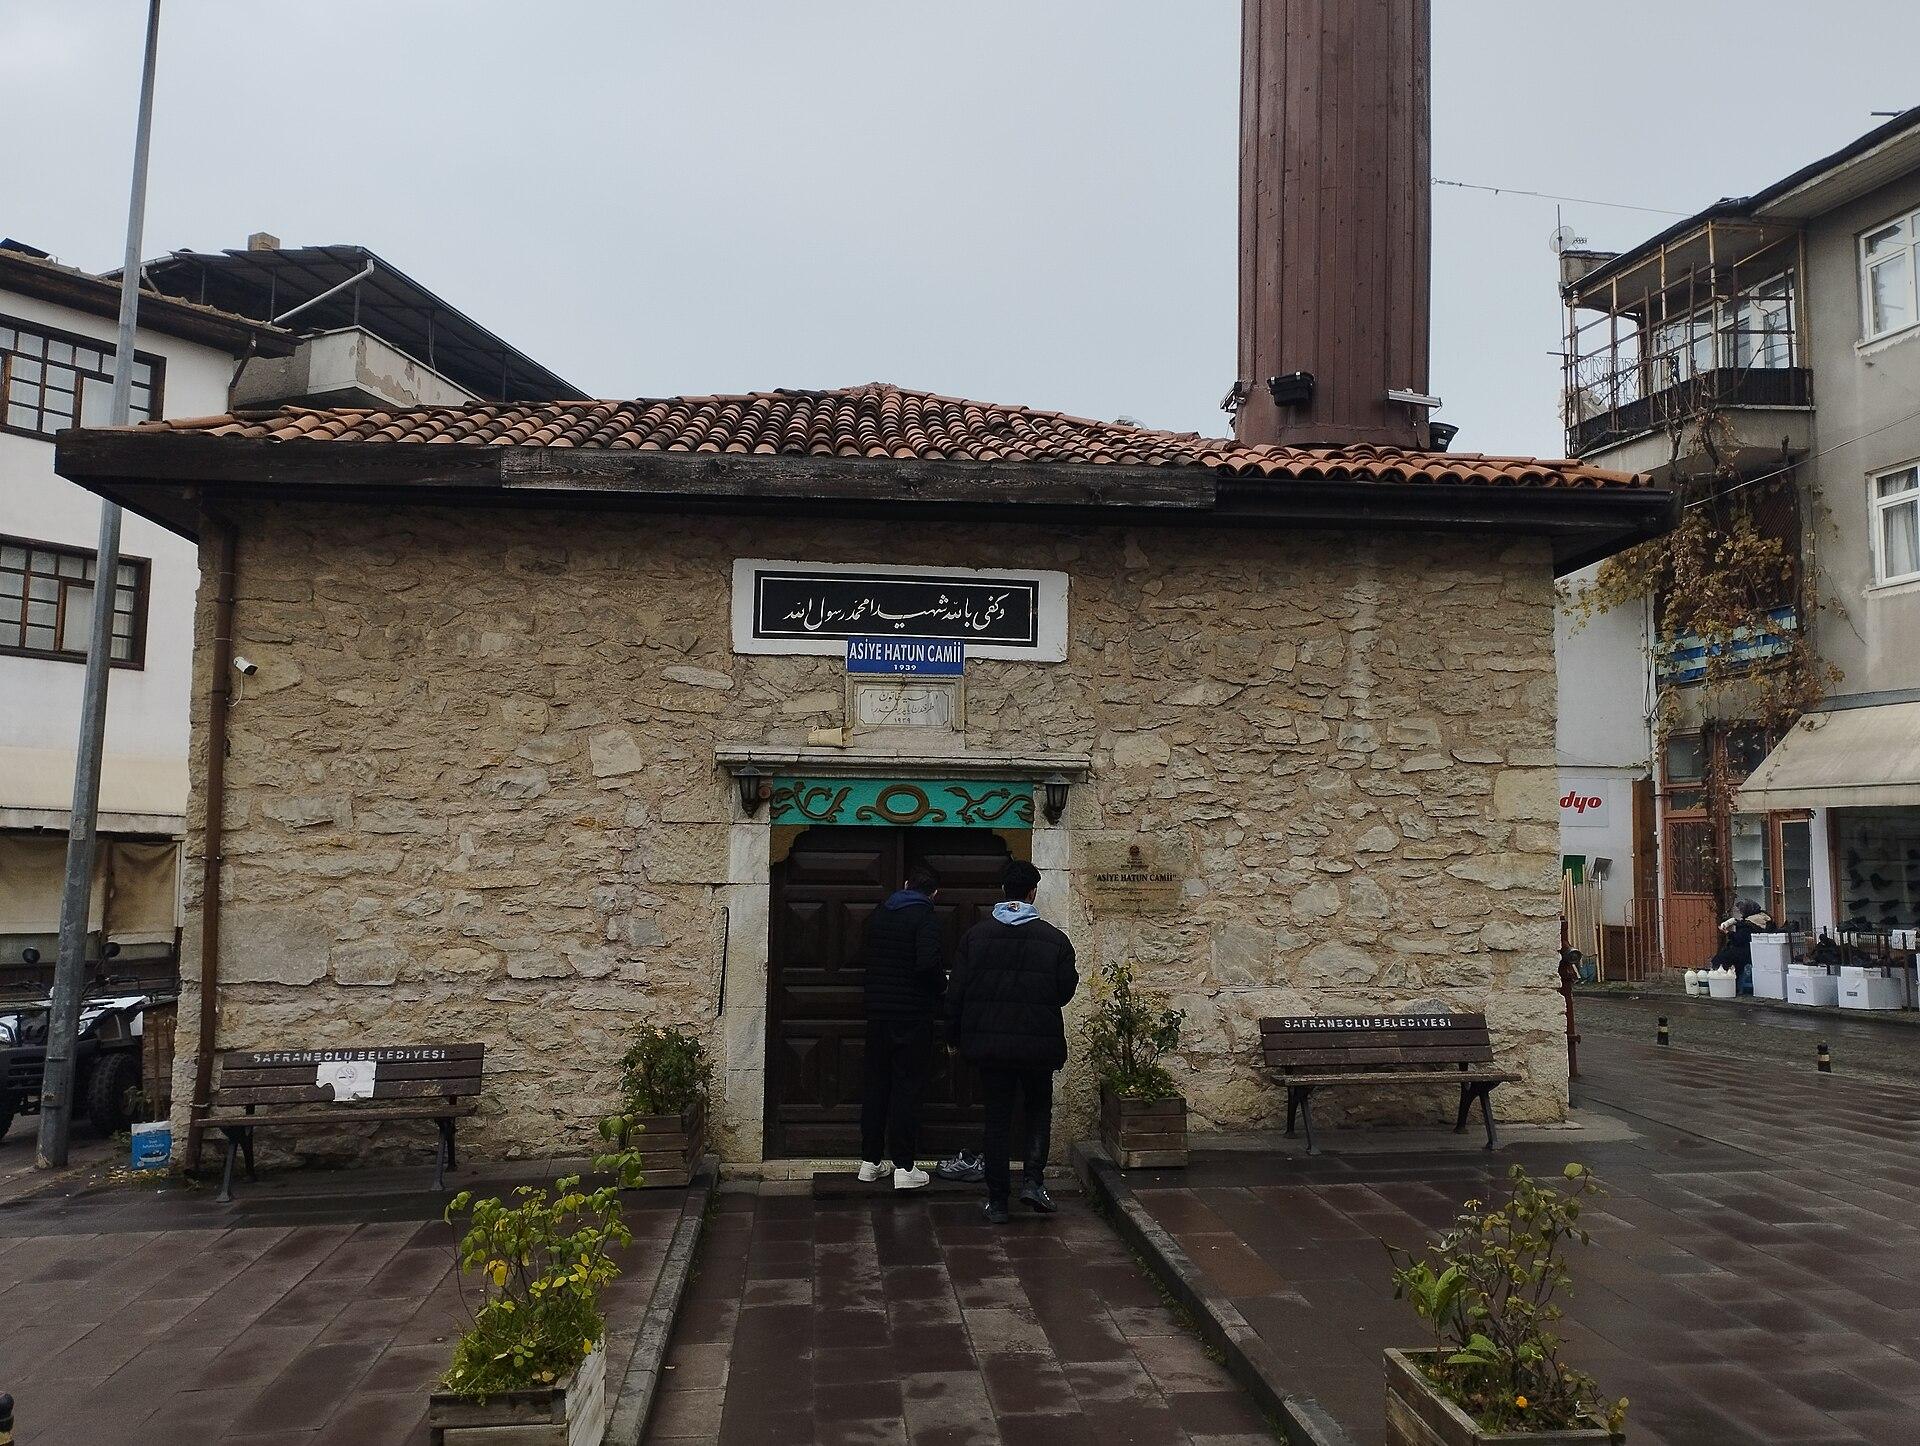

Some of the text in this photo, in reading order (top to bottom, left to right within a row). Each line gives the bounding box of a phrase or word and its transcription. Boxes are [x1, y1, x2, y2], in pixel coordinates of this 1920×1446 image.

[849, 639, 961, 663] ASİYE HATUN CAMİİ
[1559, 791, 1603, 814] dyo
[1120, 873, 1149, 882] HATUN
[1284, 1018, 1370, 1028] SAFRANBOLU
[253, 1051, 353, 1063] SAFRANBOLU
